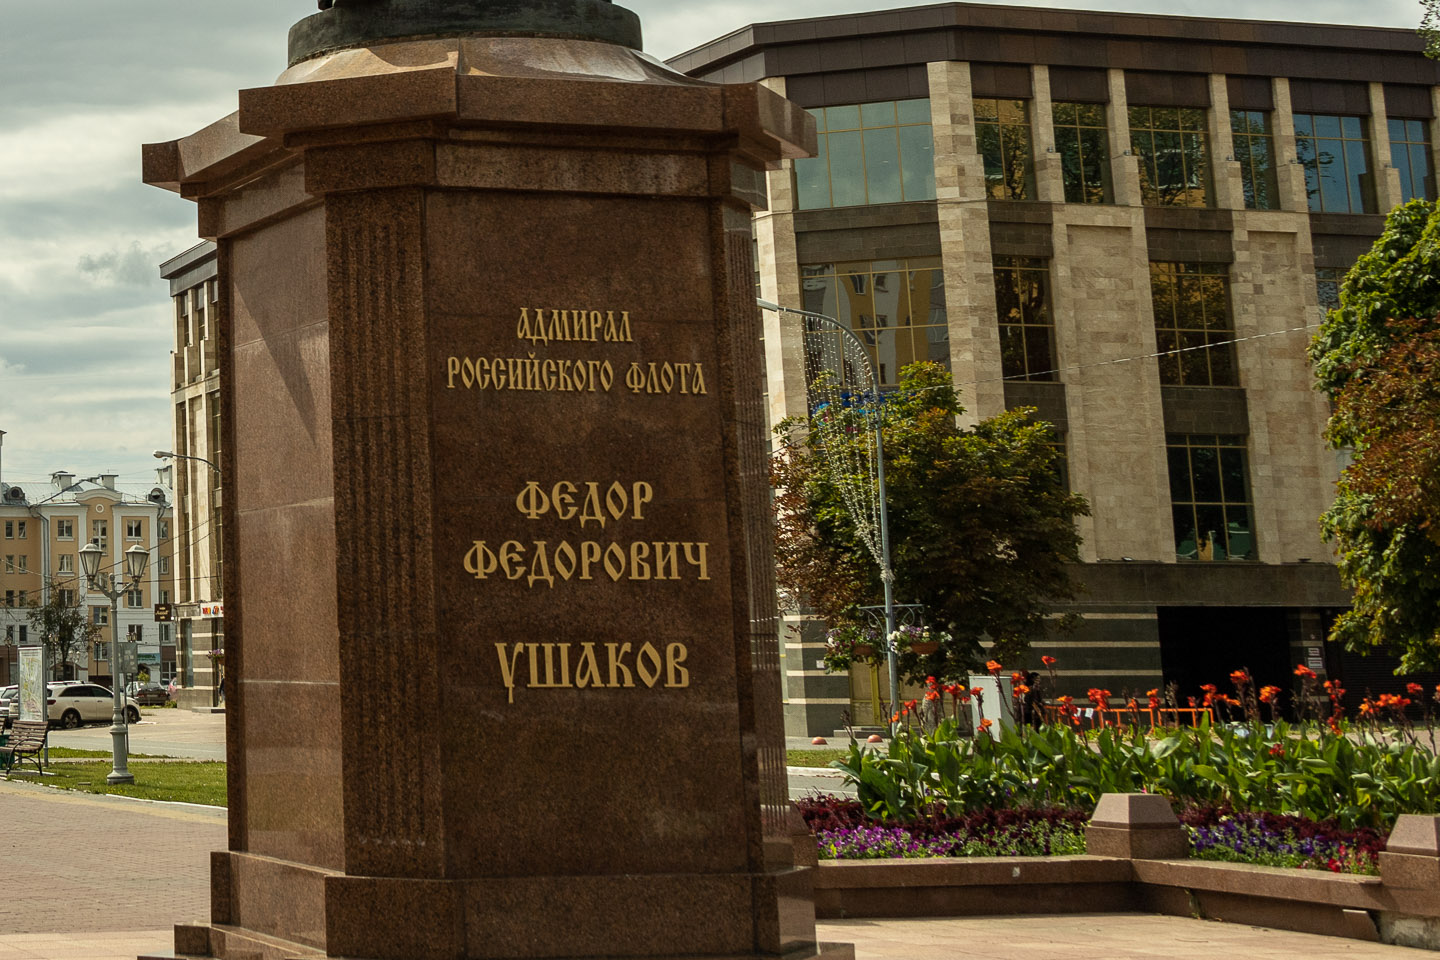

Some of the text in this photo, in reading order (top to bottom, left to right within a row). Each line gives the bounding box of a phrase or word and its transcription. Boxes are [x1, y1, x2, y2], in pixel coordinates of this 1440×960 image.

[517, 307, 633, 345] АДМИРАЛ
[447, 352, 708, 394] РОССИЙСКОГО ФЛОТА
[516, 481, 653, 528] ФЕДОР
[463, 540, 710, 588] ФЕДОРОВИЧ
[495, 641, 690, 703] УШАКОВ
